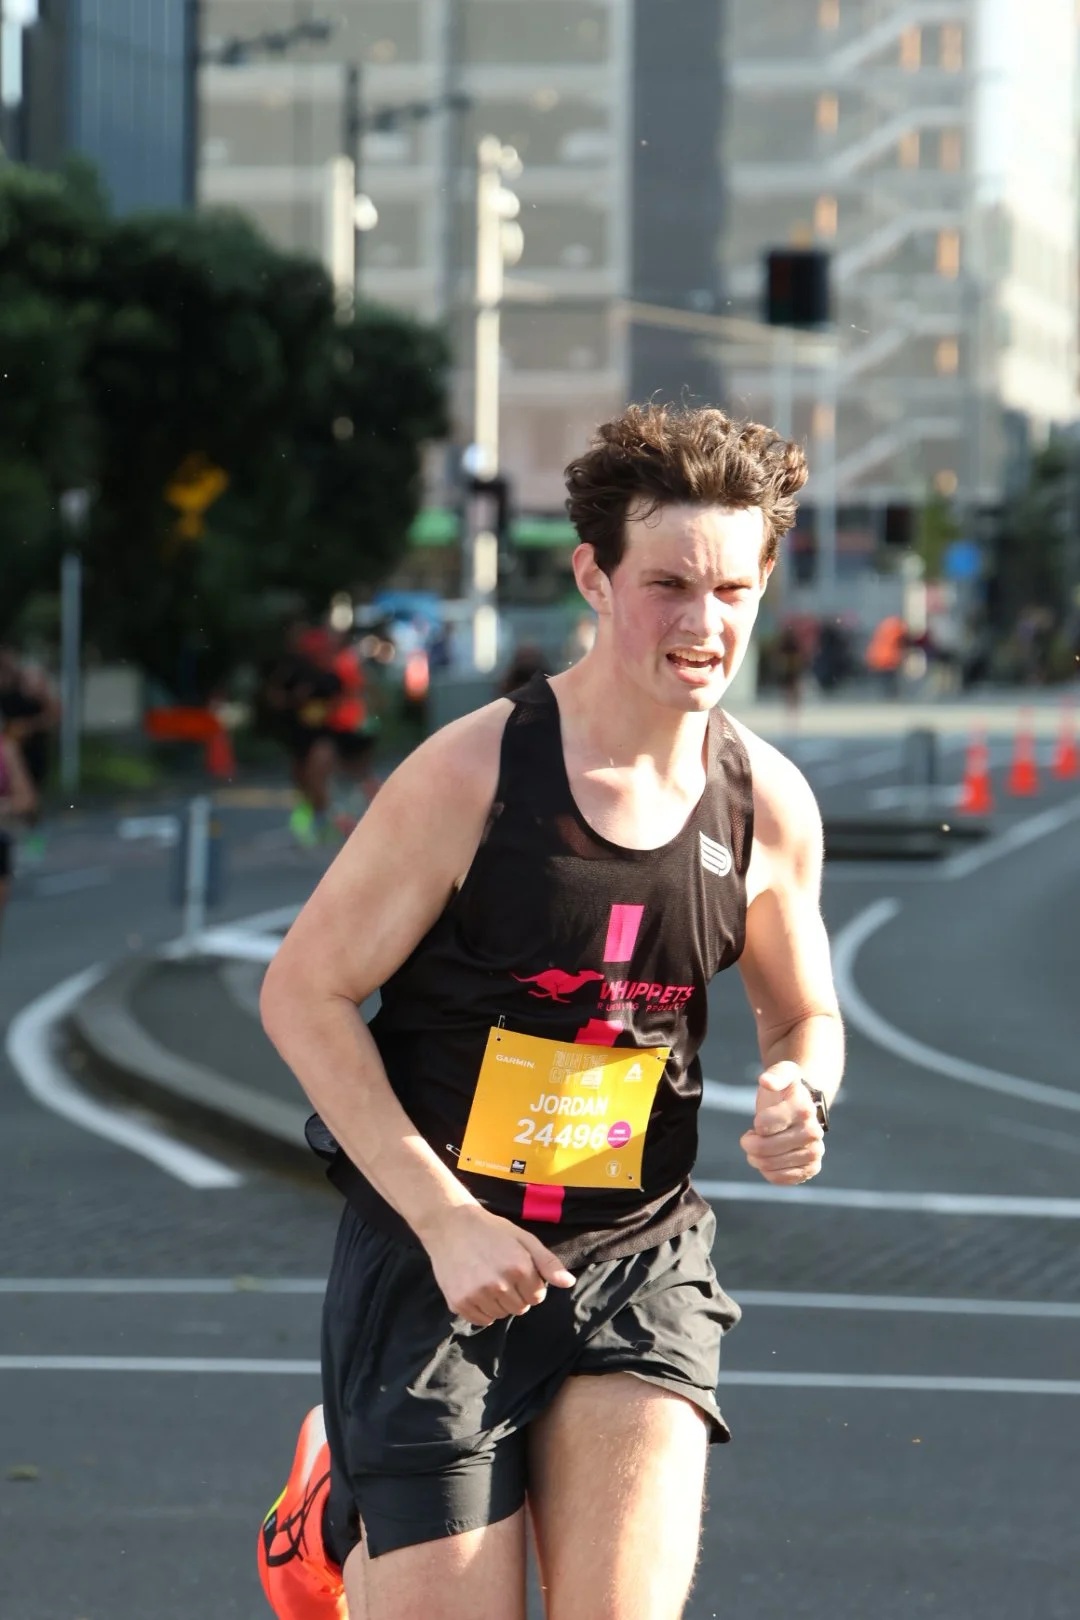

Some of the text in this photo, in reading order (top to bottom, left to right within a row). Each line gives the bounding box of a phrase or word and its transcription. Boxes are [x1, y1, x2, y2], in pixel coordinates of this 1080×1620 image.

[600, 981, 695, 1003] WHIPPETS
[496, 1054, 535, 1069] GARMIN
[530, 1094, 609, 1116] JORDAN
[514, 1119, 608, 1150] 24496
